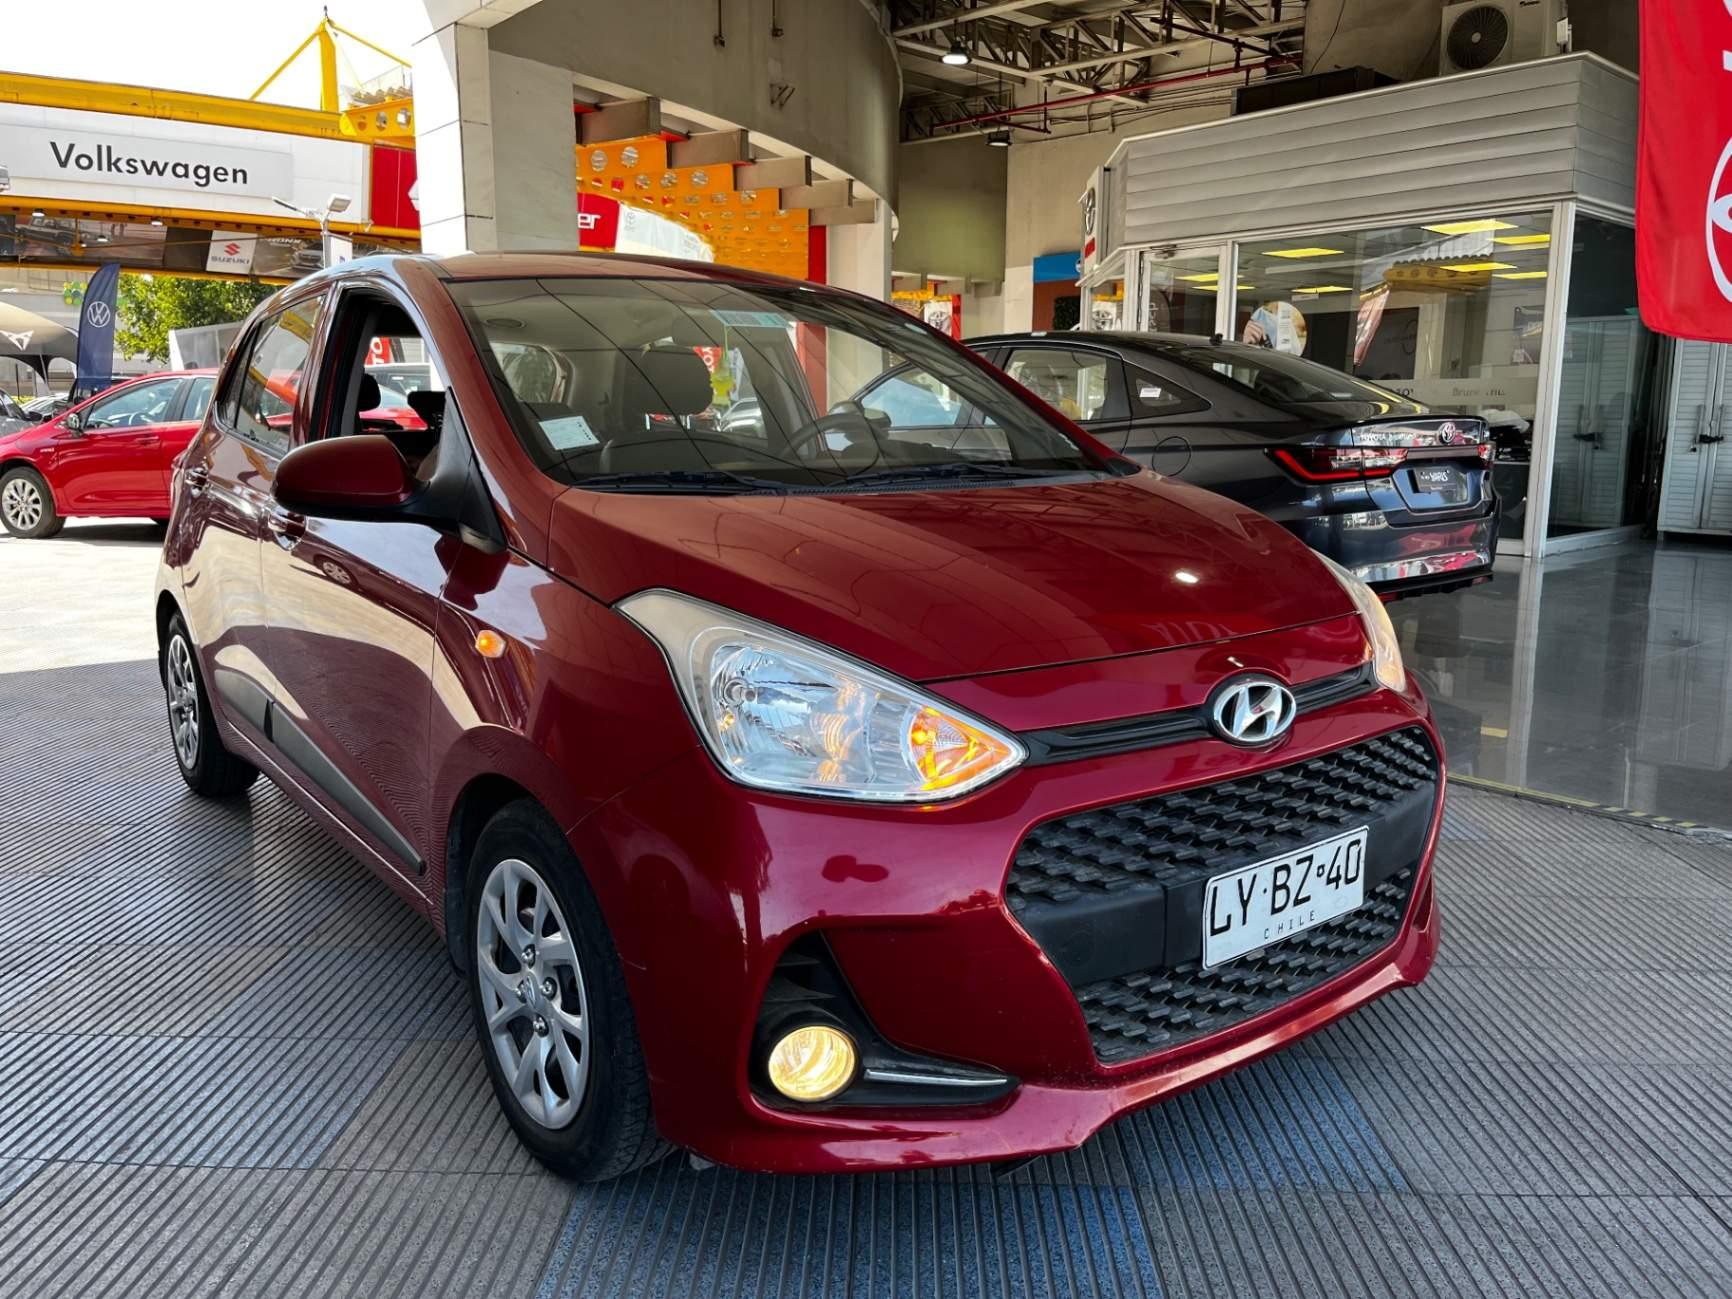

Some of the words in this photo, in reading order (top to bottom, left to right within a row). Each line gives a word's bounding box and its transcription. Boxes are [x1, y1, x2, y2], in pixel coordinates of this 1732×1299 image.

[50, 141, 248, 188] Volkswagen
[211, 256, 250, 264] SUZUKI
[1264, 910, 1316, 940] CHILE
